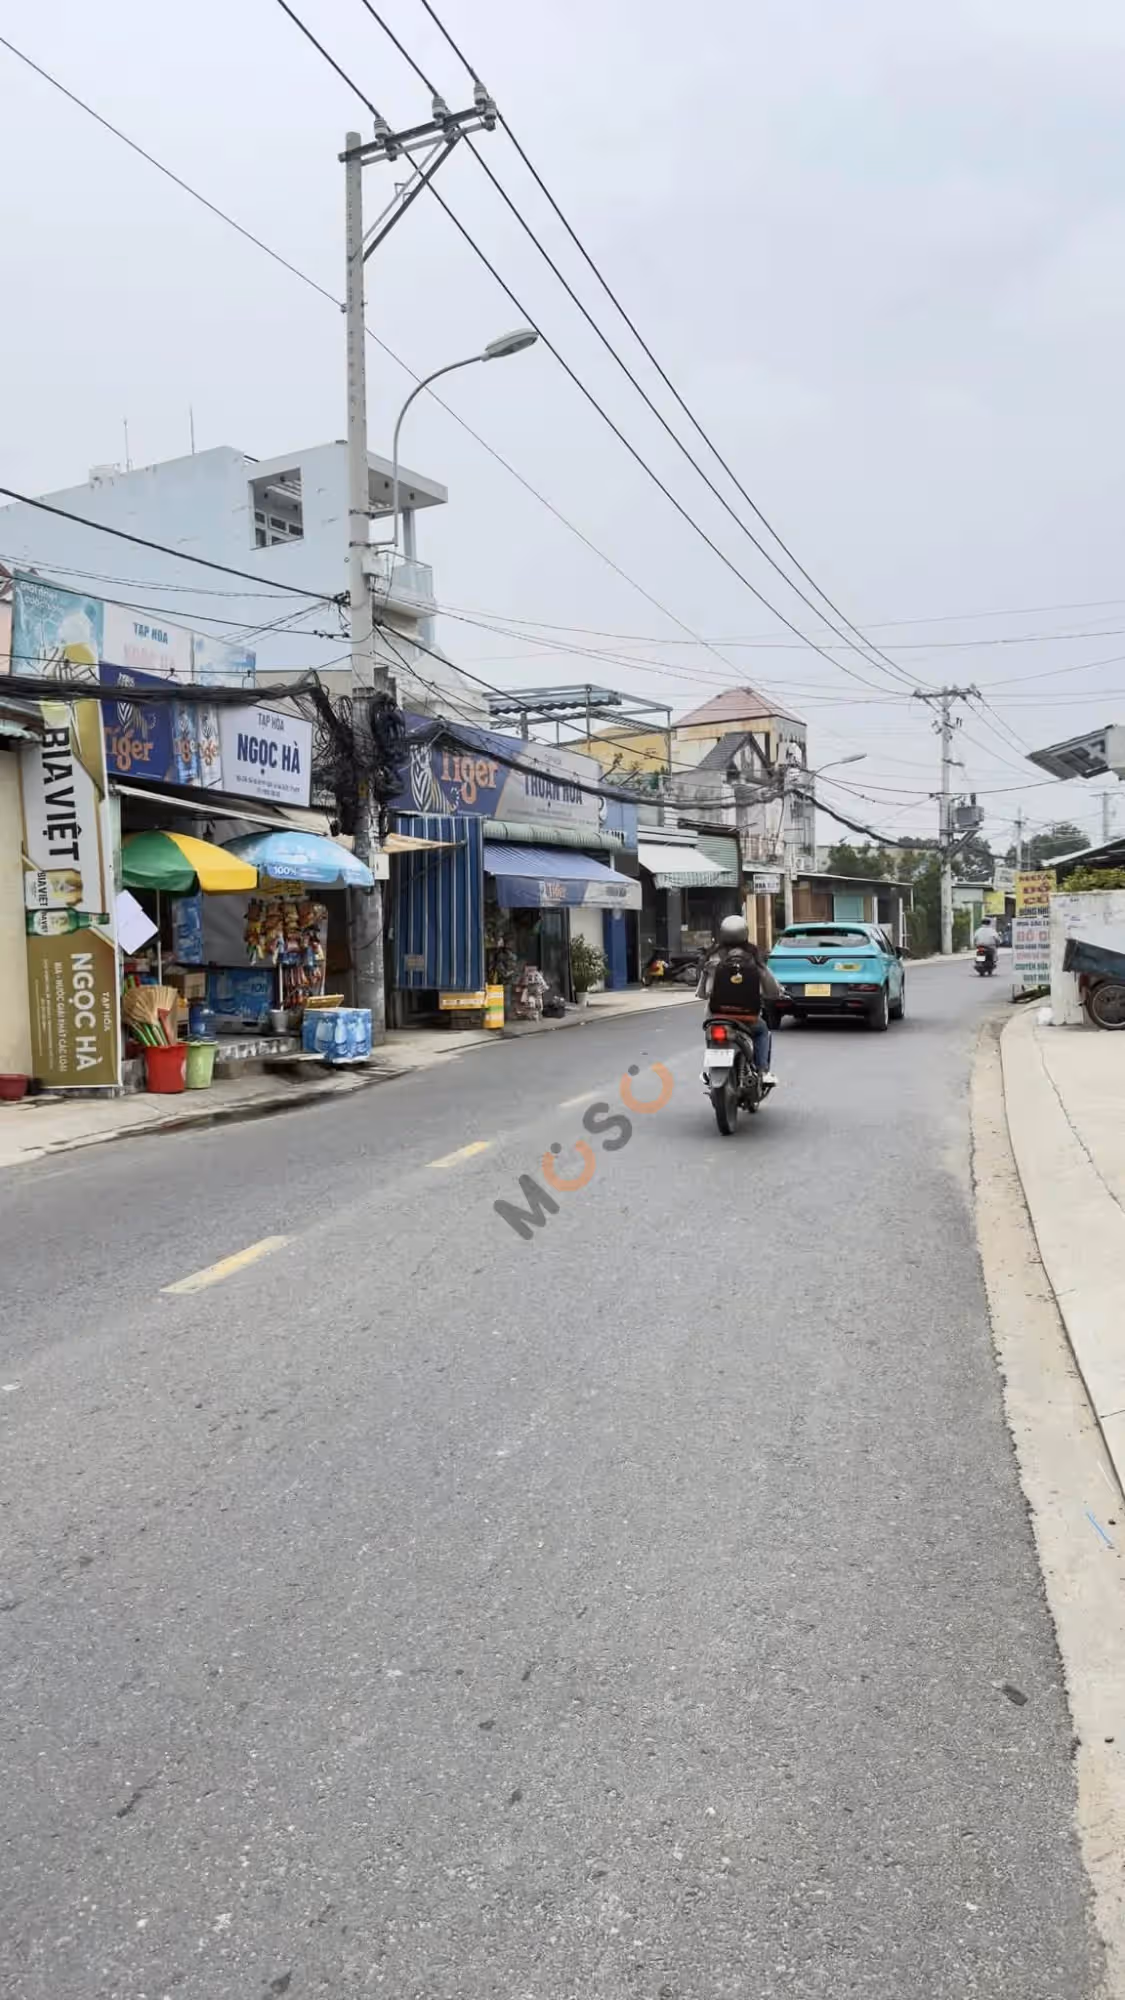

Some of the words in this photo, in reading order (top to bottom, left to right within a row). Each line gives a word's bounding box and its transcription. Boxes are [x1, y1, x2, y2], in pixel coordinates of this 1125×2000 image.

[41, 727, 73, 784] BIA
[104, 726, 154, 771] Tiger
[237, 732, 278, 775] NGỌC
[281, 741, 300, 774] HÀ
[440, 747, 498, 805] Tiger
[42, 785, 83, 862] VIỆT
[273, 864, 297, 876] 100%
[69, 952, 95, 1029] NGỌC
[75, 1034, 104, 1072] HÀ
